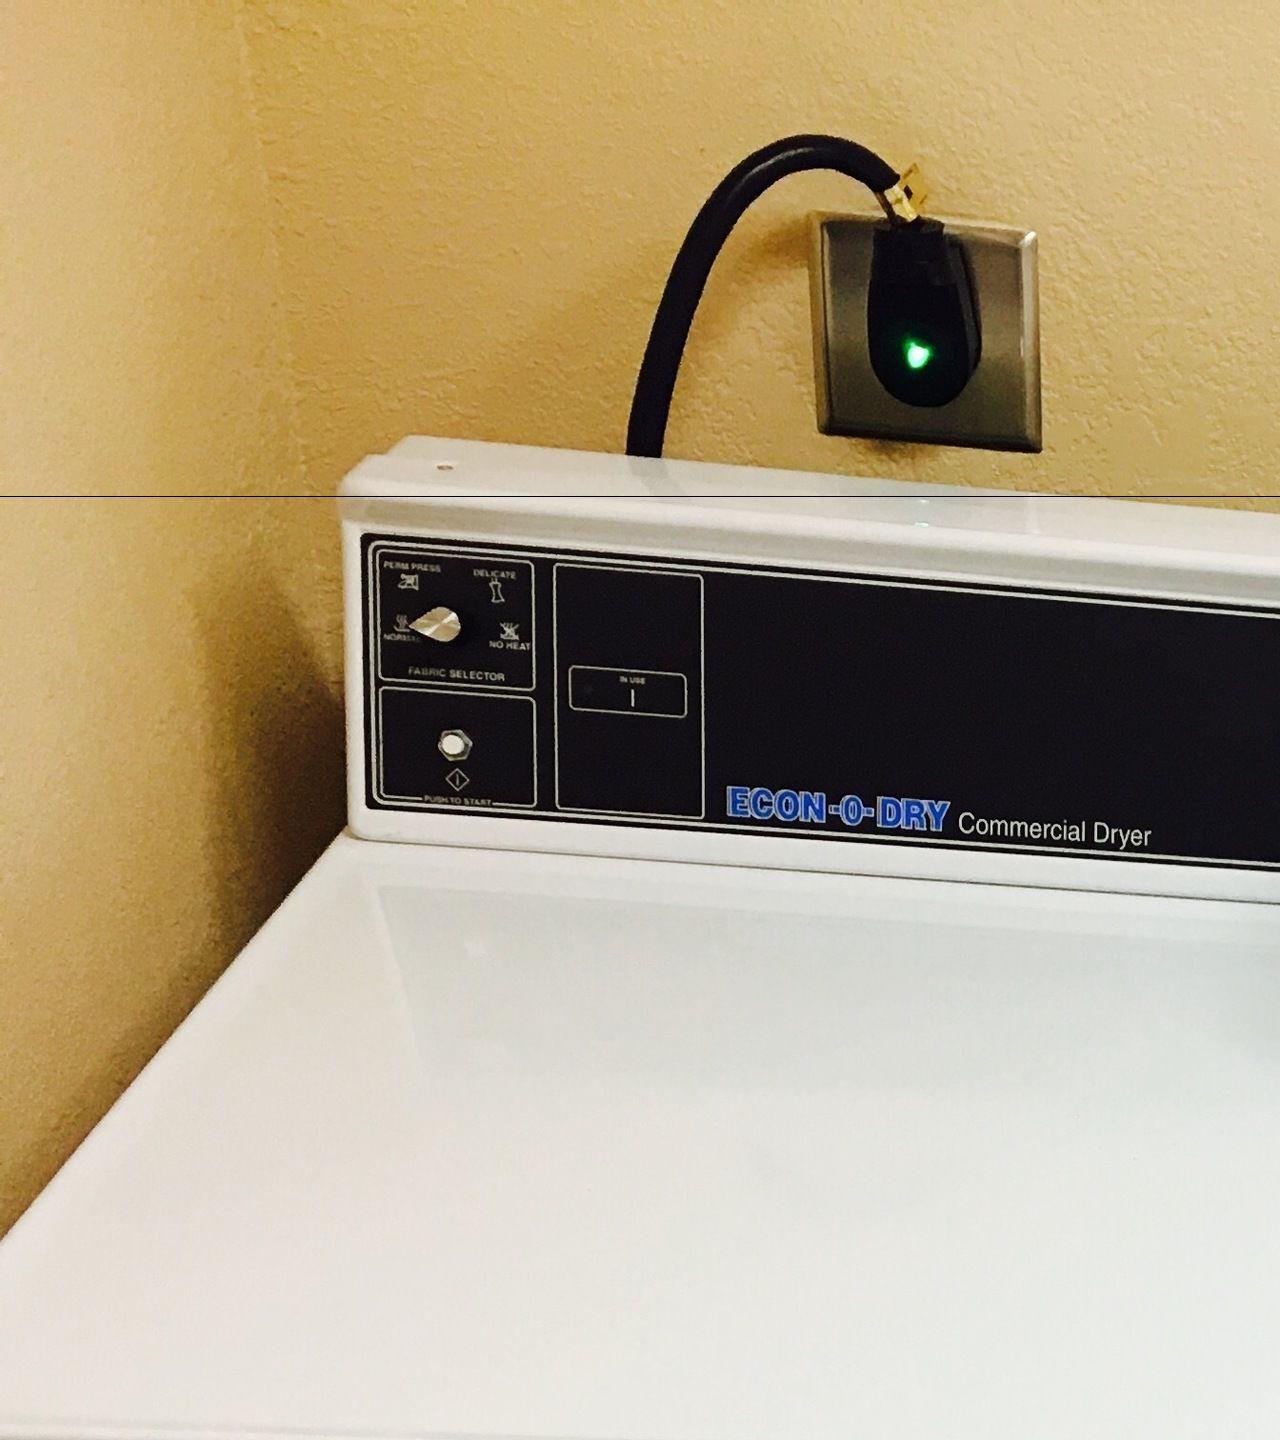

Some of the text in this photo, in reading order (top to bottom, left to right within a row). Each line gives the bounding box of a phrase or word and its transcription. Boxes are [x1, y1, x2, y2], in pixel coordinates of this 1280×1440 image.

[383, 561, 442, 572] PERM PRESS
[473, 568, 517, 580] DELICATE
[489, 640, 532, 651] NO HEAT
[408, 666, 506, 682] FABRIC SELECTOR
[619, 675, 646, 685] IN USE
[424, 794, 492, 806] PUSH TO START
[726, 785, 1152, 850] ECON-O-DRY Commercial Dryer
